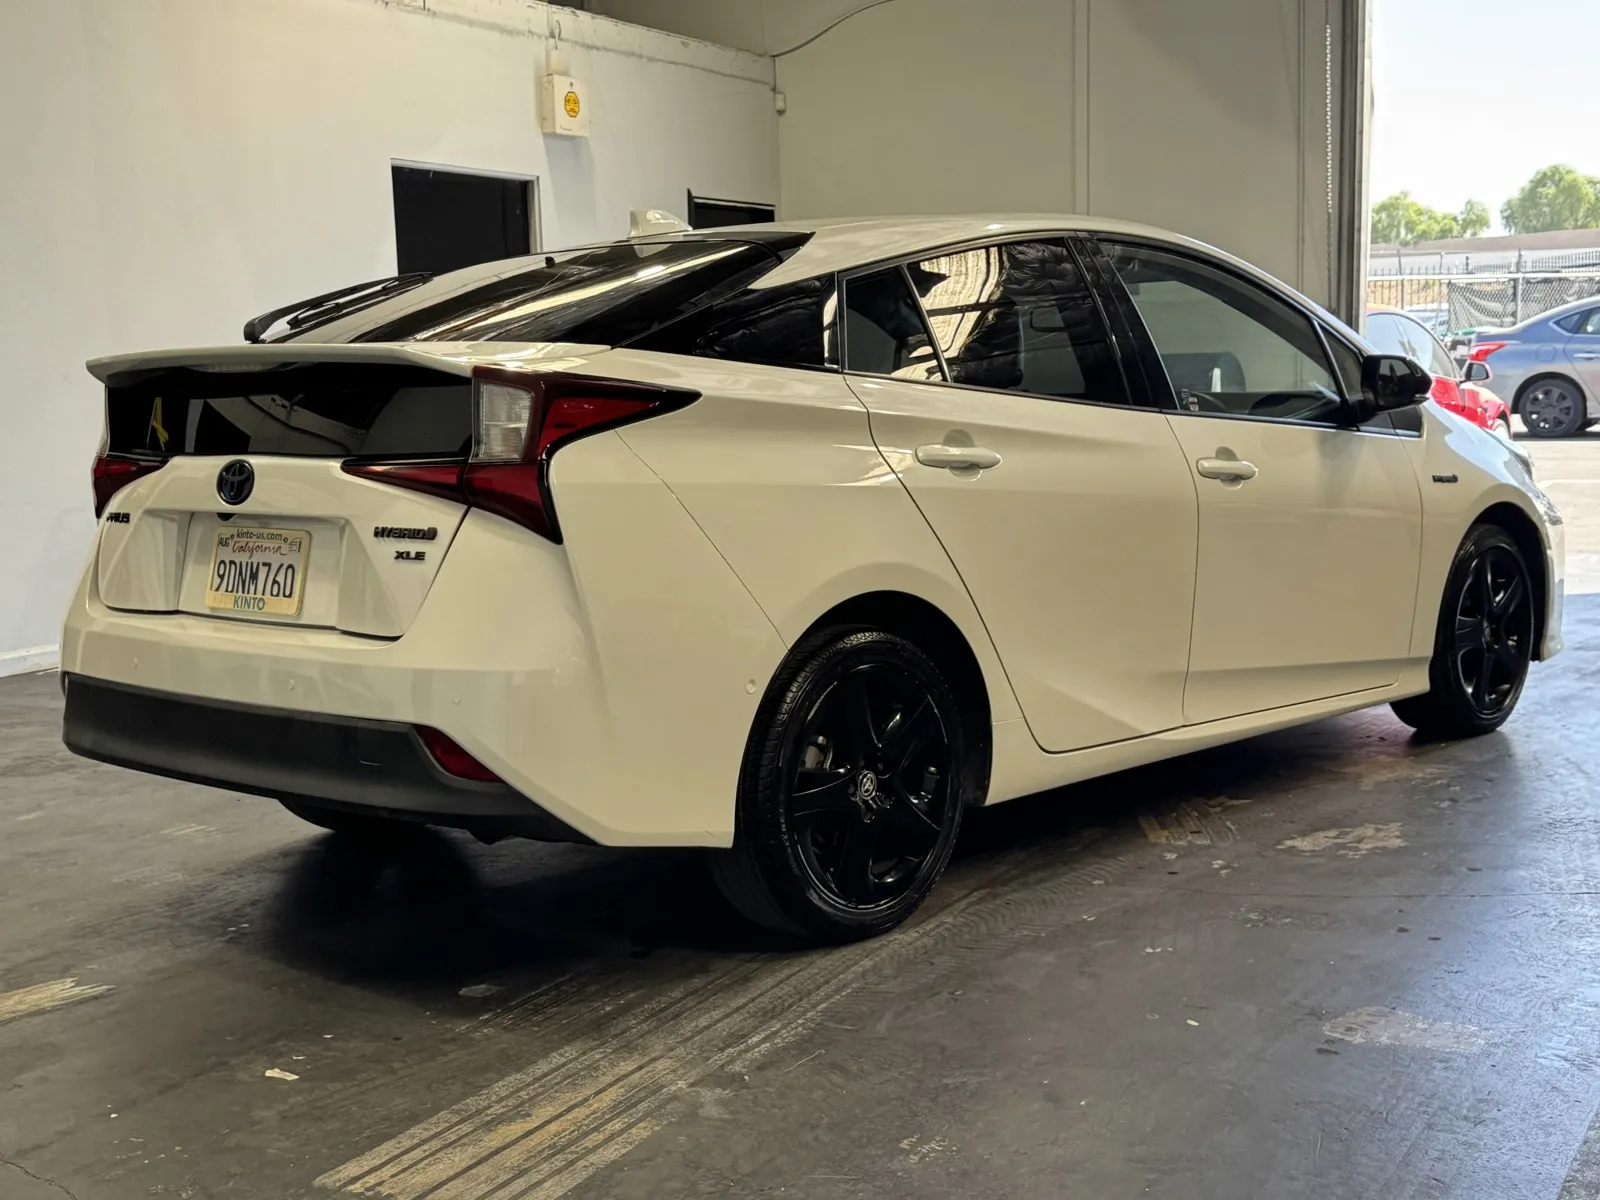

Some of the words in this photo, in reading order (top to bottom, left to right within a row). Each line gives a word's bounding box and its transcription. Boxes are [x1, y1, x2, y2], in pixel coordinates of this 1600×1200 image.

[236, 529, 282, 540] kinto-us.com
[373, 526, 428, 540] HYBRID
[232, 541, 287, 559] California
[394, 550, 426, 561] XLE
[215, 559, 295, 598] 9DNM760
[233, 595, 265, 610] KINTO
